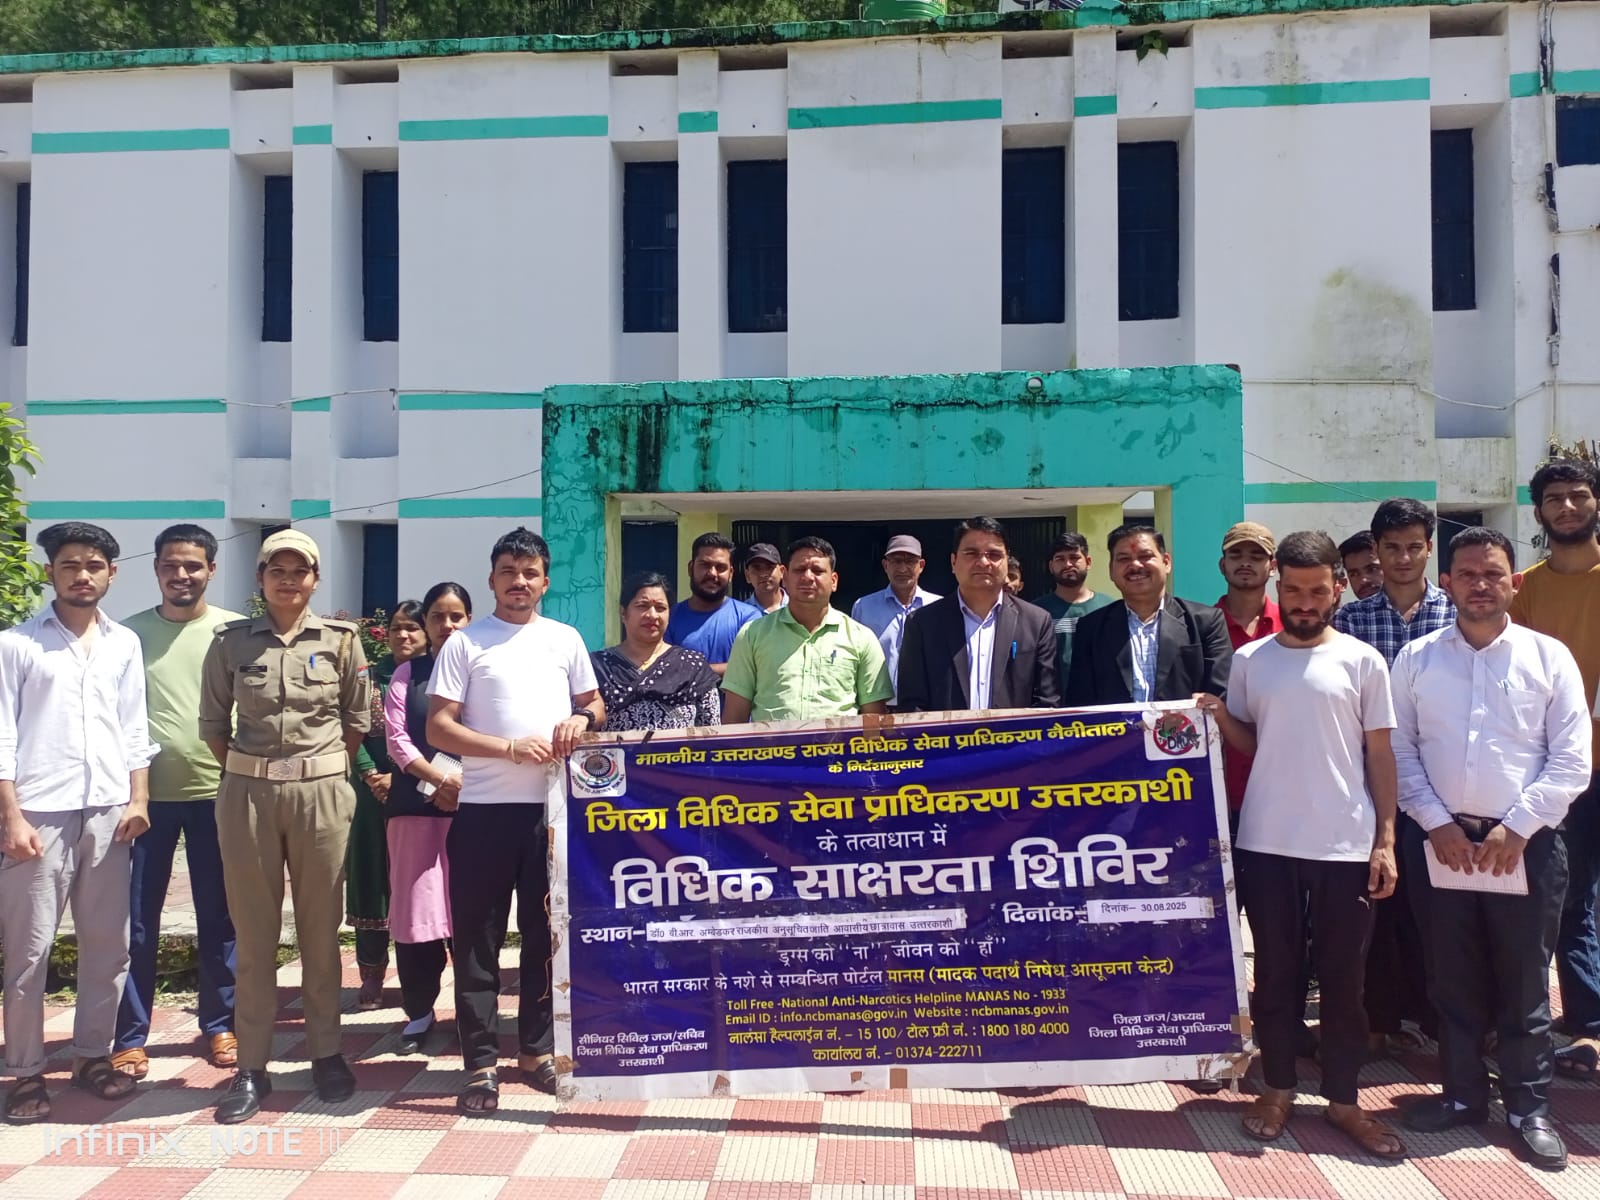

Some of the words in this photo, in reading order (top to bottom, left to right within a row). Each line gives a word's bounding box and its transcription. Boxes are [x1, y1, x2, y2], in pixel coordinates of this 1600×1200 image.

[635, 746, 706, 766] माननीय
[711, 745, 796, 762] उत्तराखण्ड
[801, 742, 845, 758] राज्य
[913, 734, 950, 750] सेवा
[956, 728, 1042, 750] प्राधिकरण
[1047, 720, 1127, 740] नैनीताल
[828, 761, 843, 774] के
[847, 759, 924, 775] निर्देशानुसार
[585, 802, 668, 833] जिला
[676, 795, 781, 829] विधिक
[788, 791, 854, 823] सेवा
[863, 784, 1020, 822] प्राधिकरण
[1029, 767, 1193, 808] उत्तरकाशी
[816, 829, 838, 853] के
[844, 831, 925, 851] तत्वाधान
[930, 822, 947, 847] में
[609, 856, 778, 909] विधिक
[790, 855, 994, 901] साक्षरता
[1008, 834, 1173, 890] शिविर
[1141, 901, 1187, 912] 30.08.2025
[910, 918, 953, 930] उत्तरकाशी
[777, 948, 809, 966] ड्रग्स
[891, 940, 932, 959] जीवन
[938, 937, 960, 956] को
[623, 980, 658, 995] भारत
[663, 977, 710, 993] सरकार
[714, 973, 728, 990] के
[732, 971, 756, 989] नशे
[760, 970, 773, 988] से
[843, 966, 883, 984] पोर्टल
[886, 968, 925, 984] मानस
[928, 966, 977, 985] (मादक
[982, 961, 1020, 980] पदार्थ
[1024, 960, 1066, 978] निषेध
[1071, 961, 1133, 981] आसूचना
[1137, 955, 1175, 976] केन्द्र)
[727, 999, 747, 1011] Toll
[750, 999, 774, 1010] Free
[831, 994, 912, 1007] Anti-Narcotics
[915, 992, 962, 1005] Helpline
[965, 990, 1011, 1002] MANAS
[1014, 989, 1031, 1001] No
[1041, 989, 1066, 1000] 1933
[725, 1014, 756, 1025] Email
[759, 1013, 771, 1024] ID
[780, 1007, 908, 1024] info.ncbmanas@gov.in
[914, 1005, 962, 1018] Website
[971, 1003, 1069, 1018] ncbmanas.gov.in
[1113, 1013, 1141, 1025] जिला
[858, 1028, 872, 1040] 15
[906, 1023, 929, 1038] टोल
[932, 1022, 950, 1037] फ्री
[981, 1024, 1009, 1036] 1800
[1014, 1024, 1036, 1035] 180
[1039, 1022, 1070, 1035] 4000
[1088, 1026, 1117, 1038] जिला
[1120, 1025, 1154, 1037] विधिक
[1157, 1023, 1179, 1034] सेवा
[1181, 1021, 1232, 1035] प्राधिकरण
[577, 1045, 602, 1057] जिला
[638, 1043, 659, 1055] सेवा
[1136, 1035, 1187, 1048] उत्तरकाशी
[812, 1045, 862, 1061] कार्यालय
[895, 1045, 982, 1059] 01374-222711
